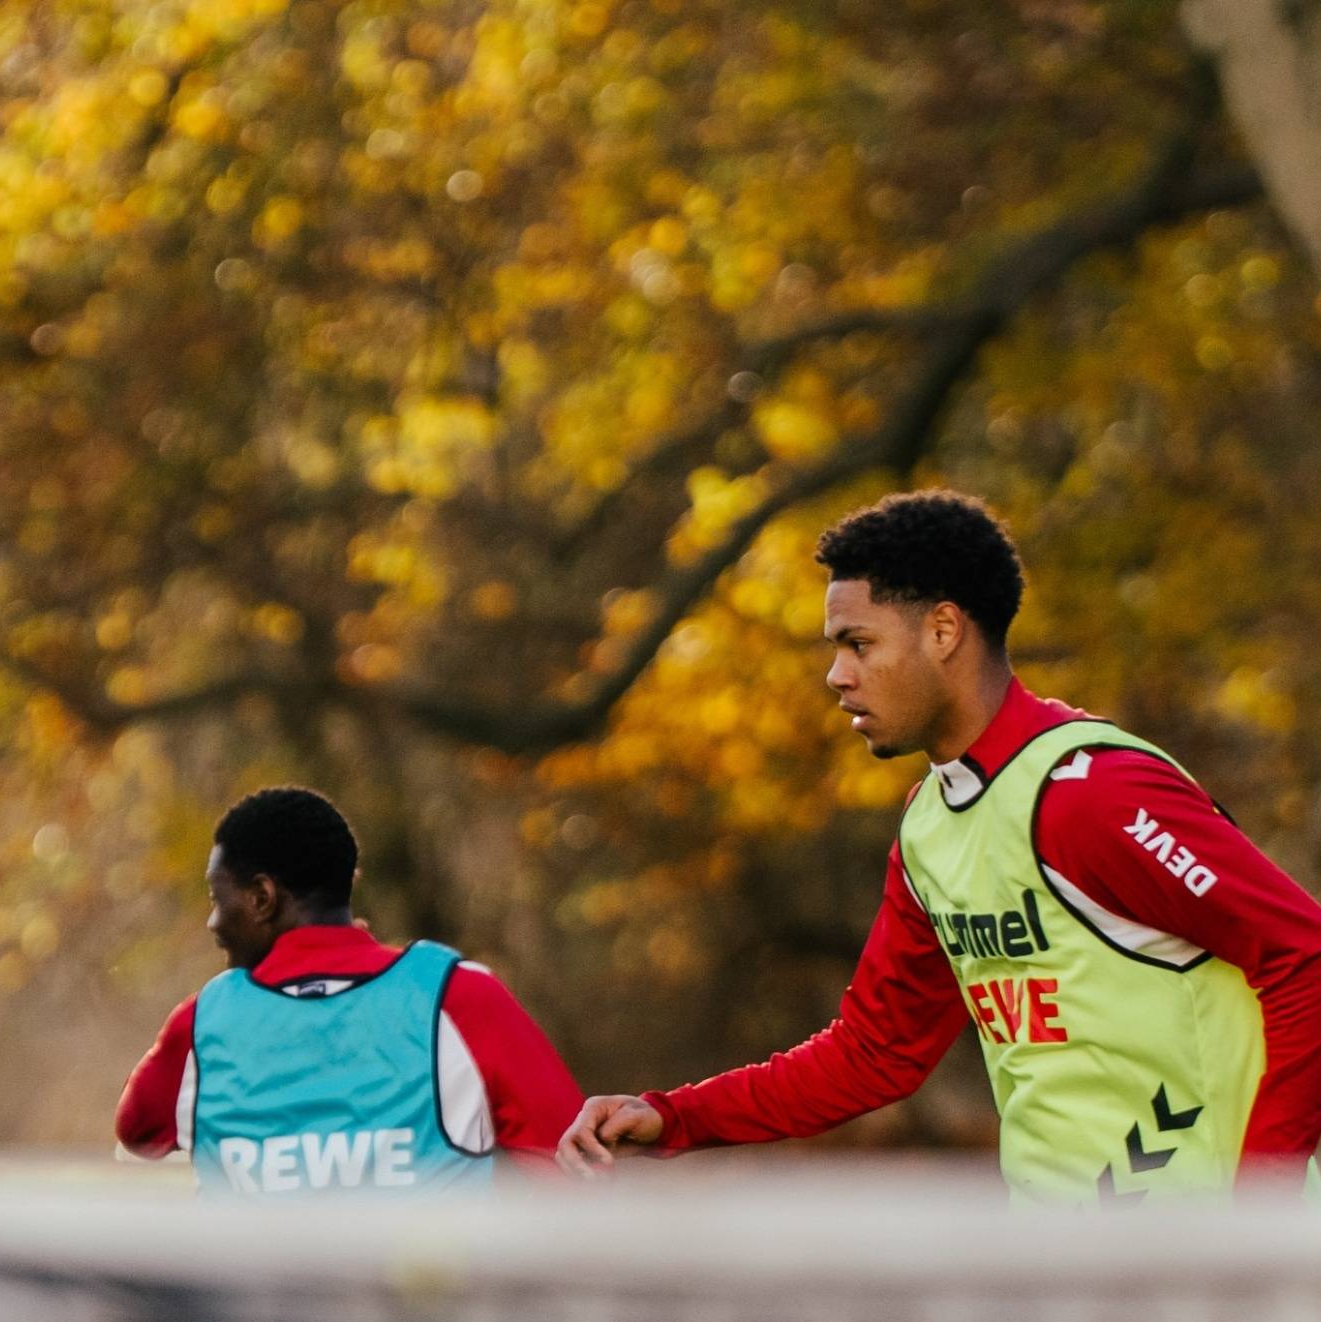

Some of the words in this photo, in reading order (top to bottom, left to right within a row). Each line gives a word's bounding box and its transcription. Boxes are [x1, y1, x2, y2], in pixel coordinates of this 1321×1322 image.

[1122, 807, 1219, 898] DEVK
[966, 977, 1068, 1045] EWE
[219, 1127, 416, 1193] REWE
